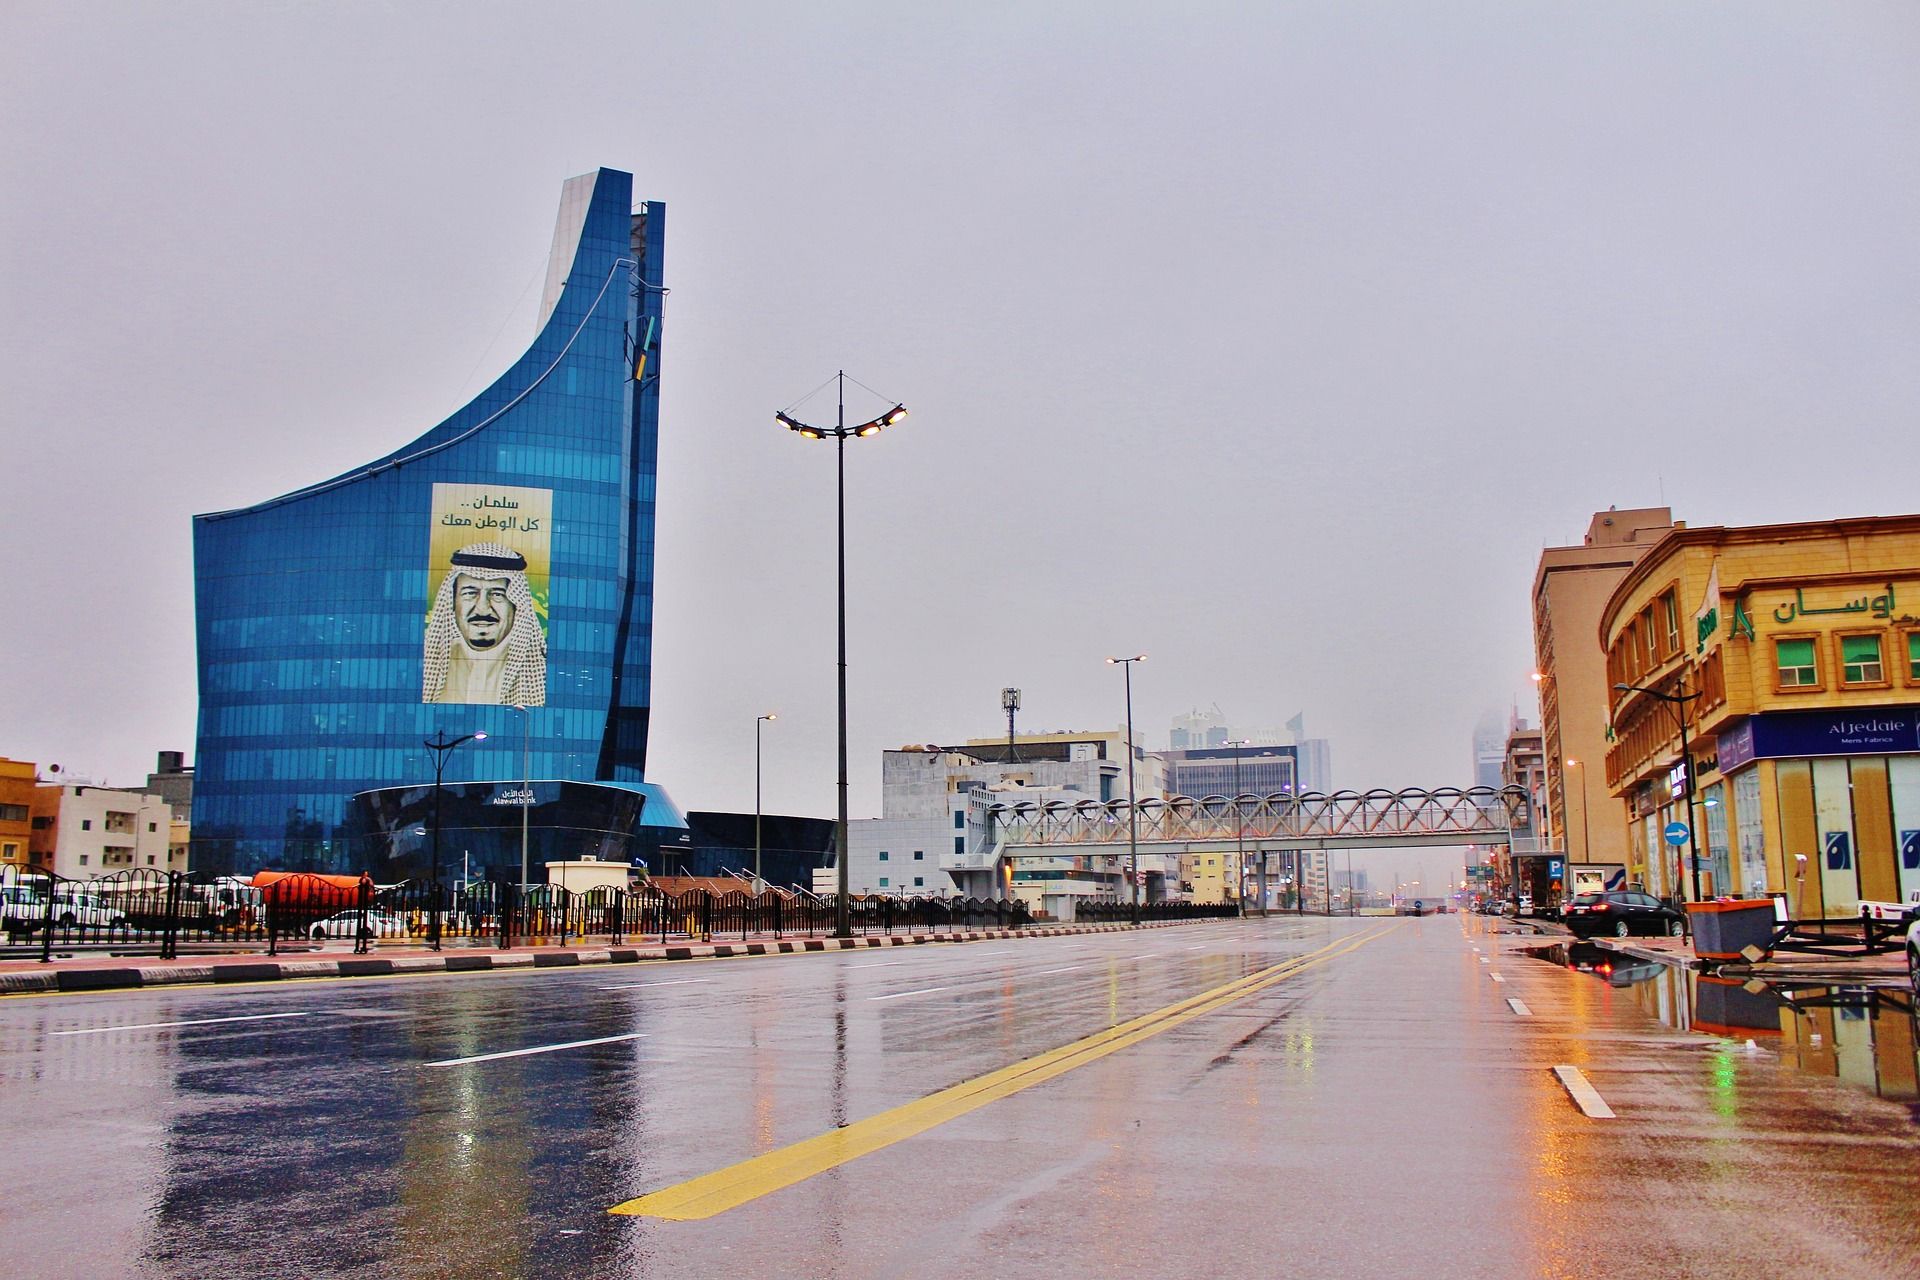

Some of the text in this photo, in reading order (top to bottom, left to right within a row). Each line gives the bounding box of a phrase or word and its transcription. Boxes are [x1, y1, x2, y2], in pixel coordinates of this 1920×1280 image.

[473, 495, 518, 509] سلمان
[441, 513, 540, 532] كل الوطن معك
[1774, 582, 1896, 624] أوسان
[1551, 861, 1561, 873] P
